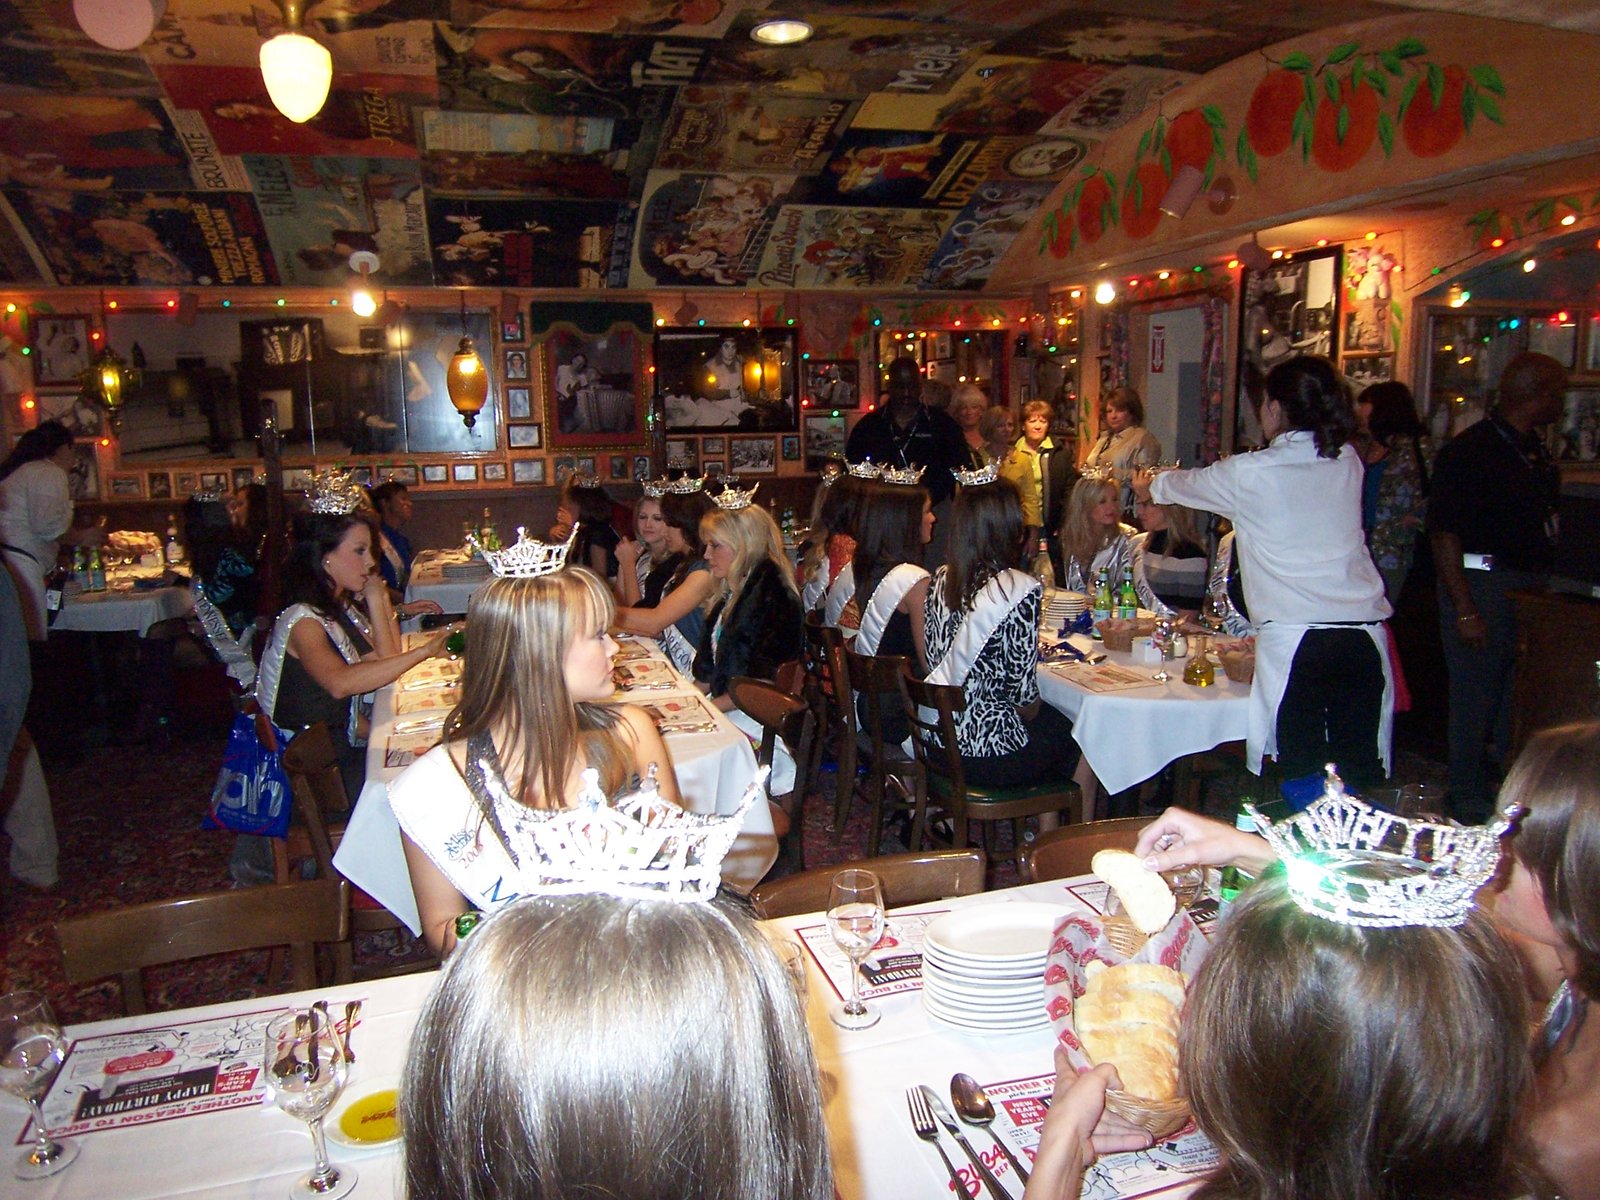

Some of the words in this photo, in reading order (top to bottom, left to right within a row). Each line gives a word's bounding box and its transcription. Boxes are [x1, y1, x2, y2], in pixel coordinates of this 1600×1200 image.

[363, 87, 393, 143] STREGA
[794, 102, 844, 158] ARANCIO
[182, 133, 227, 187] BRUNATE
[210, 249, 232, 282] MINIERE
[239, 237, 264, 283] ROMAGNA
[859, 987, 890, 997] BUCA
[164, 1084, 210, 1102] HAPPY
[220, 1084, 243, 1092] NEW
[987, 1082, 1040, 1095] NOTHER
[82, 1095, 159, 1117] BIRTHDAY!
[192, 1094, 265, 1111] ANOTHER
[96, 1118, 114, 1127] TO
[122, 1106, 186, 1123] REASON
[47, 1122, 91, 1136] BUCA
